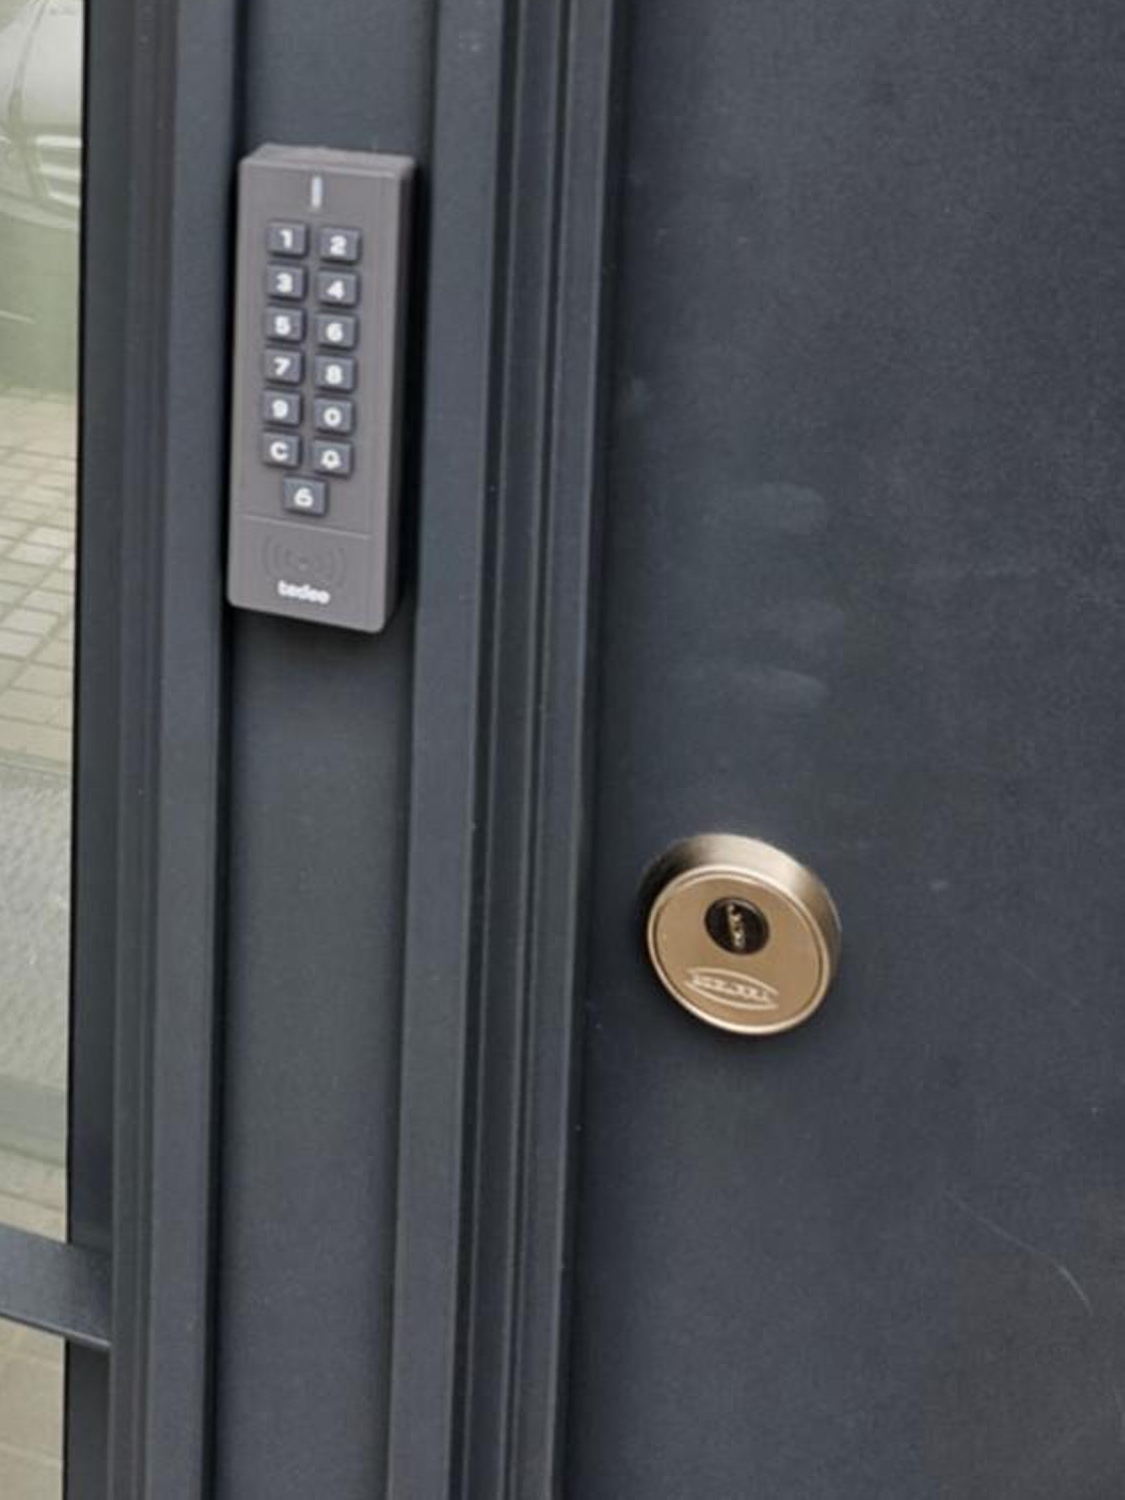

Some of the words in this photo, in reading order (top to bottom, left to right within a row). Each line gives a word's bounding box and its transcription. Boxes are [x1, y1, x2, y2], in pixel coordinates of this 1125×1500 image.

[280, 229, 292, 248] 1
[330, 235, 346, 255] 2
[277, 273, 292, 293] 3
[327, 280, 344, 299] 4
[275, 315, 291, 335] 5
[326, 322, 343, 342] 6
[274, 357, 290, 375] 7
[325, 365, 343, 384] 8
[323, 407, 342, 427] 0
[270, 441, 288, 461] C
